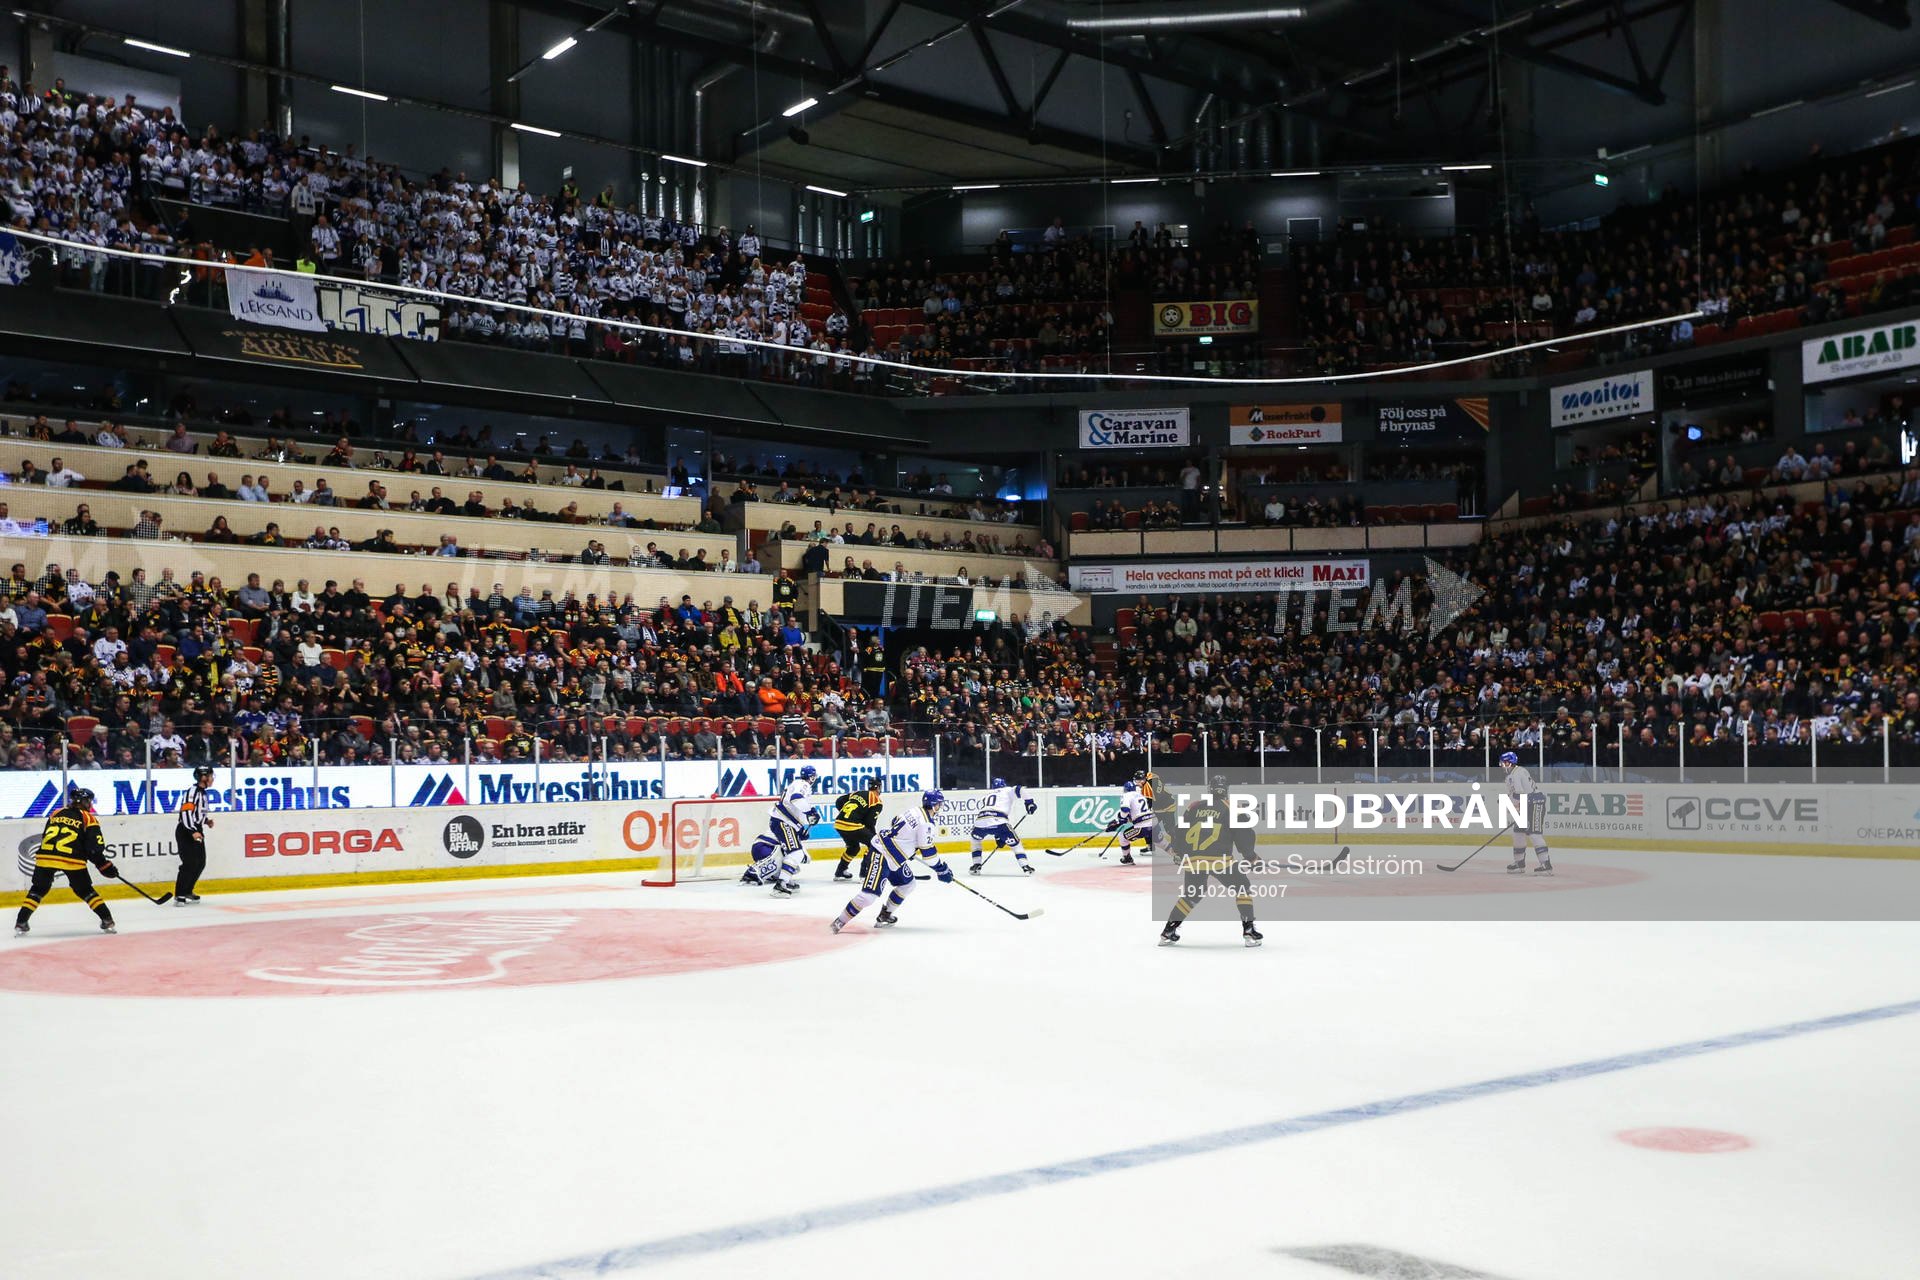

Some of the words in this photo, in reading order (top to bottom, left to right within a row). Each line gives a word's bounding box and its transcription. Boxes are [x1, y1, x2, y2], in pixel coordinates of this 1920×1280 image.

[240, 299, 313, 322] LEKSAND
[1189, 302, 1252, 327] BIG
[241, 337, 360, 366] ARENA
[1817, 325, 1917, 365] ABAB
[1561, 380, 1639, 411] monitor
[1379, 407, 1405, 420] Följ
[1406, 408, 1428, 418] oss
[1429, 405, 1447, 420] på
[1561, 411, 1584, 421] ERP
[1591, 401, 1640, 416] SYSTEM
[1100, 417, 1177, 431] Caravan
[1379, 420, 1436, 433] #brynas
[1114, 430, 1179, 445] Marine
[1265, 429, 1322, 439] RockPart
[1126, 570, 1154, 581] Hela
[1157, 568, 1206, 580] veckans
[1208, 568, 1233, 579] mat
[1235, 566, 1252, 581] på
[1255, 566, 1272, 578] ett
[1274, 566, 1304, 578] klick!
[768, 767, 920, 796] Mresjöhus
[113, 777, 350, 814] Myesjöhus
[1547, 793, 1627, 816] EAB
[1705, 798, 1819, 822] CCVE
[450, 823, 463, 833] EN
[492, 824, 514, 838] En
[517, 823, 545, 837] bra
[548, 821, 586, 836] affär
[622, 810, 741, 852] Otera
[1553, 821, 1643, 831] SAMHÄLLSBYGGARE
[1706, 823, 1787, 832] SVENSKA
[1798, 824, 1818, 833] AB
[41, 825, 78, 854] 22
[245, 828, 404, 858] BORGA
[449, 840, 479, 852] AFFÄR
[450, 832, 470, 842] BRA
[105, 841, 179, 859] STELLU
